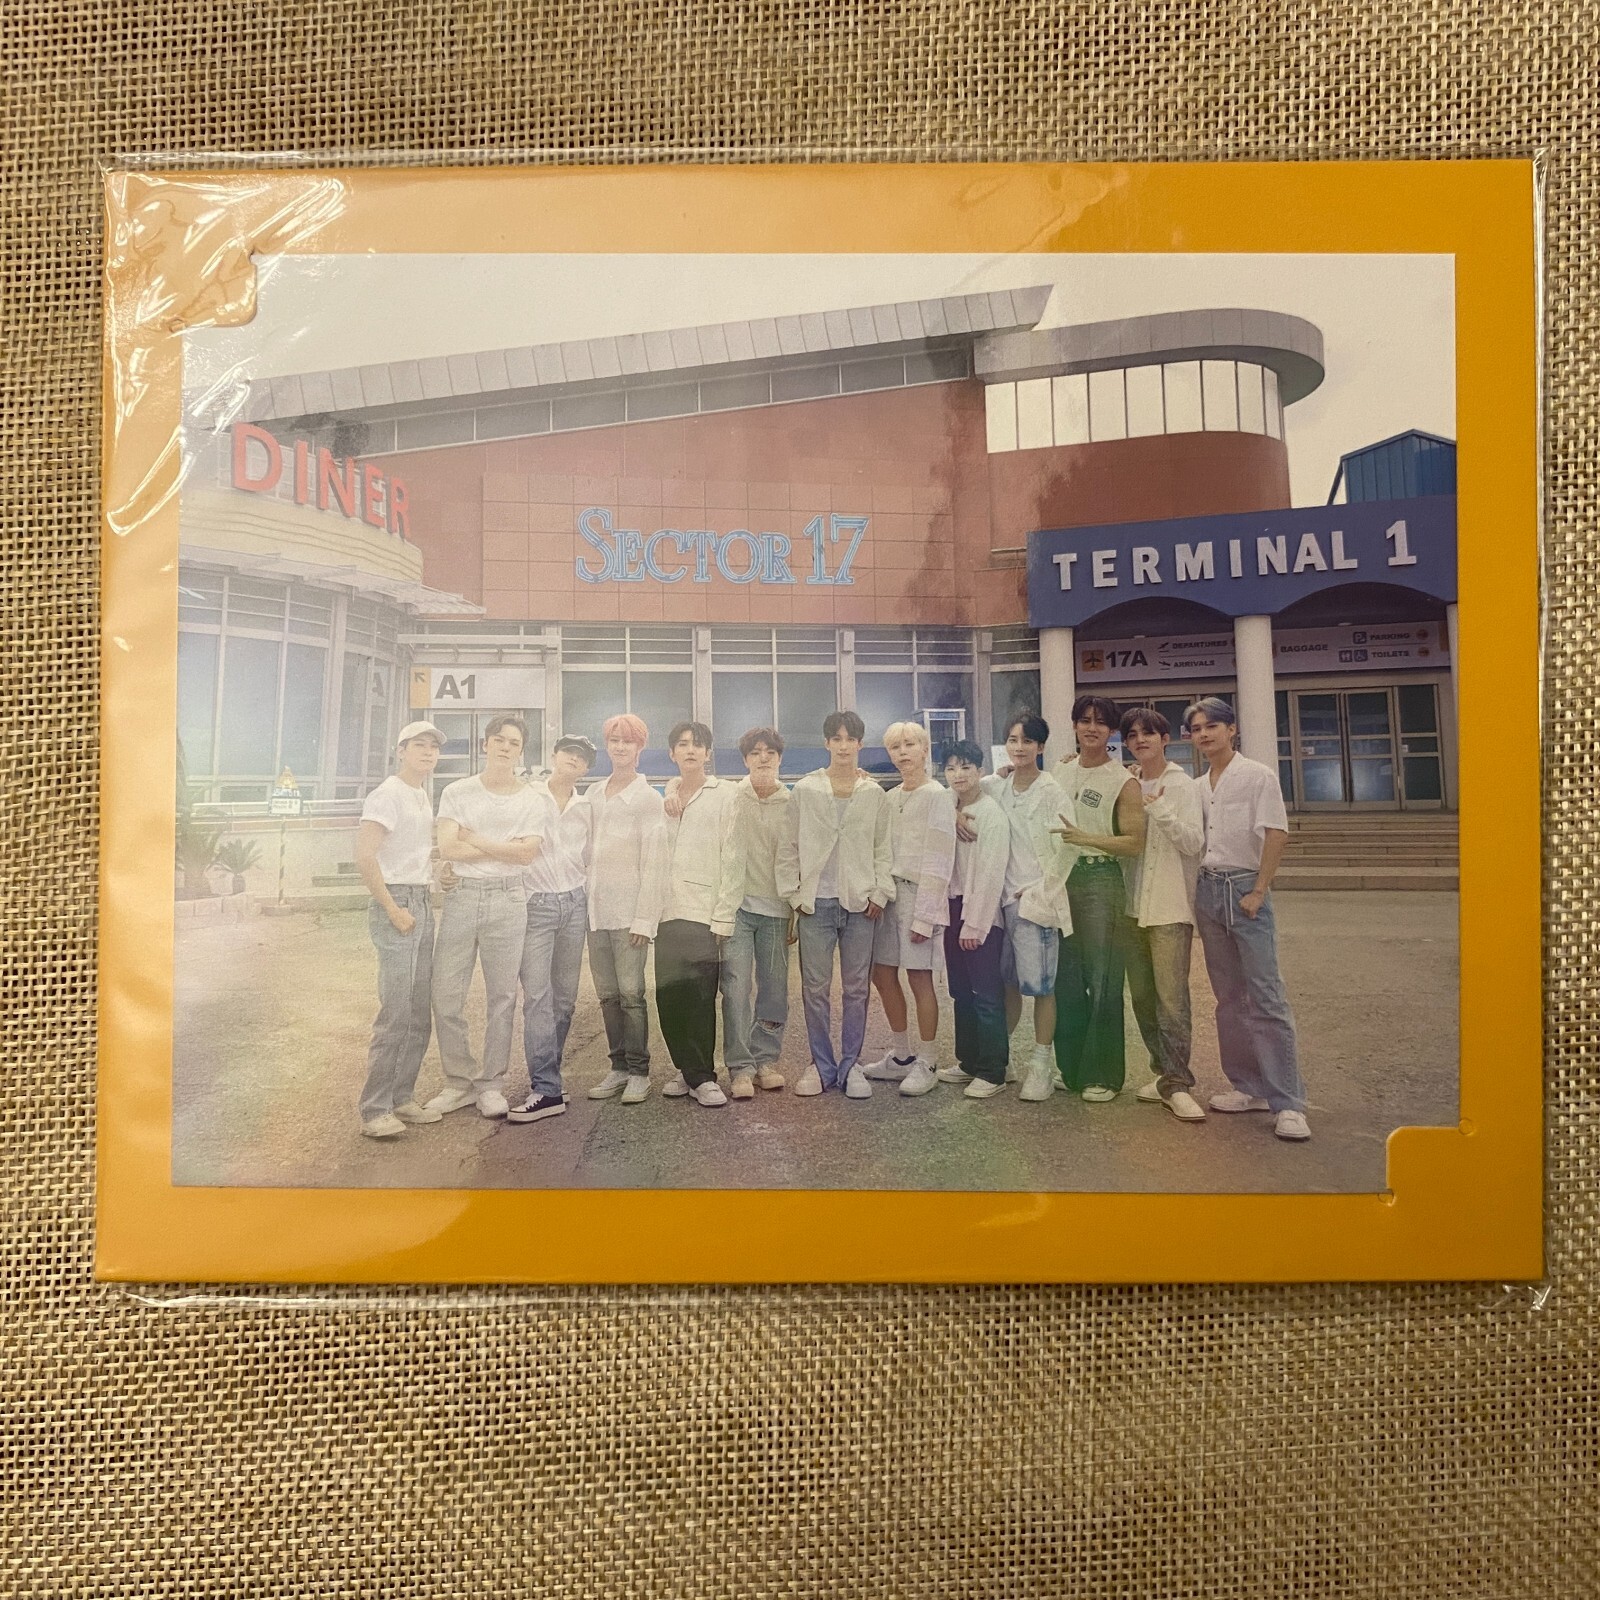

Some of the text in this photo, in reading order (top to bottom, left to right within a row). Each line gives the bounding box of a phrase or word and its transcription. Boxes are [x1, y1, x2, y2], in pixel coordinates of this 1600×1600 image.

[231, 421, 411, 541] DINER
[575, 507, 870, 585] SECTOR 17
[1052, 519, 1418, 591] TERMINAL 1
[1370, 632, 1410, 641] PARKING
[1171, 639, 1228, 649] DEPARTURES
[1280, 643, 1329, 653] BAGGAGE
[1105, 650, 1148, 668] 17A
[1371, 650, 1410, 658] TOILETS
[1173, 659, 1215, 668] ARRIVALS
[434, 674, 476, 700] A1
